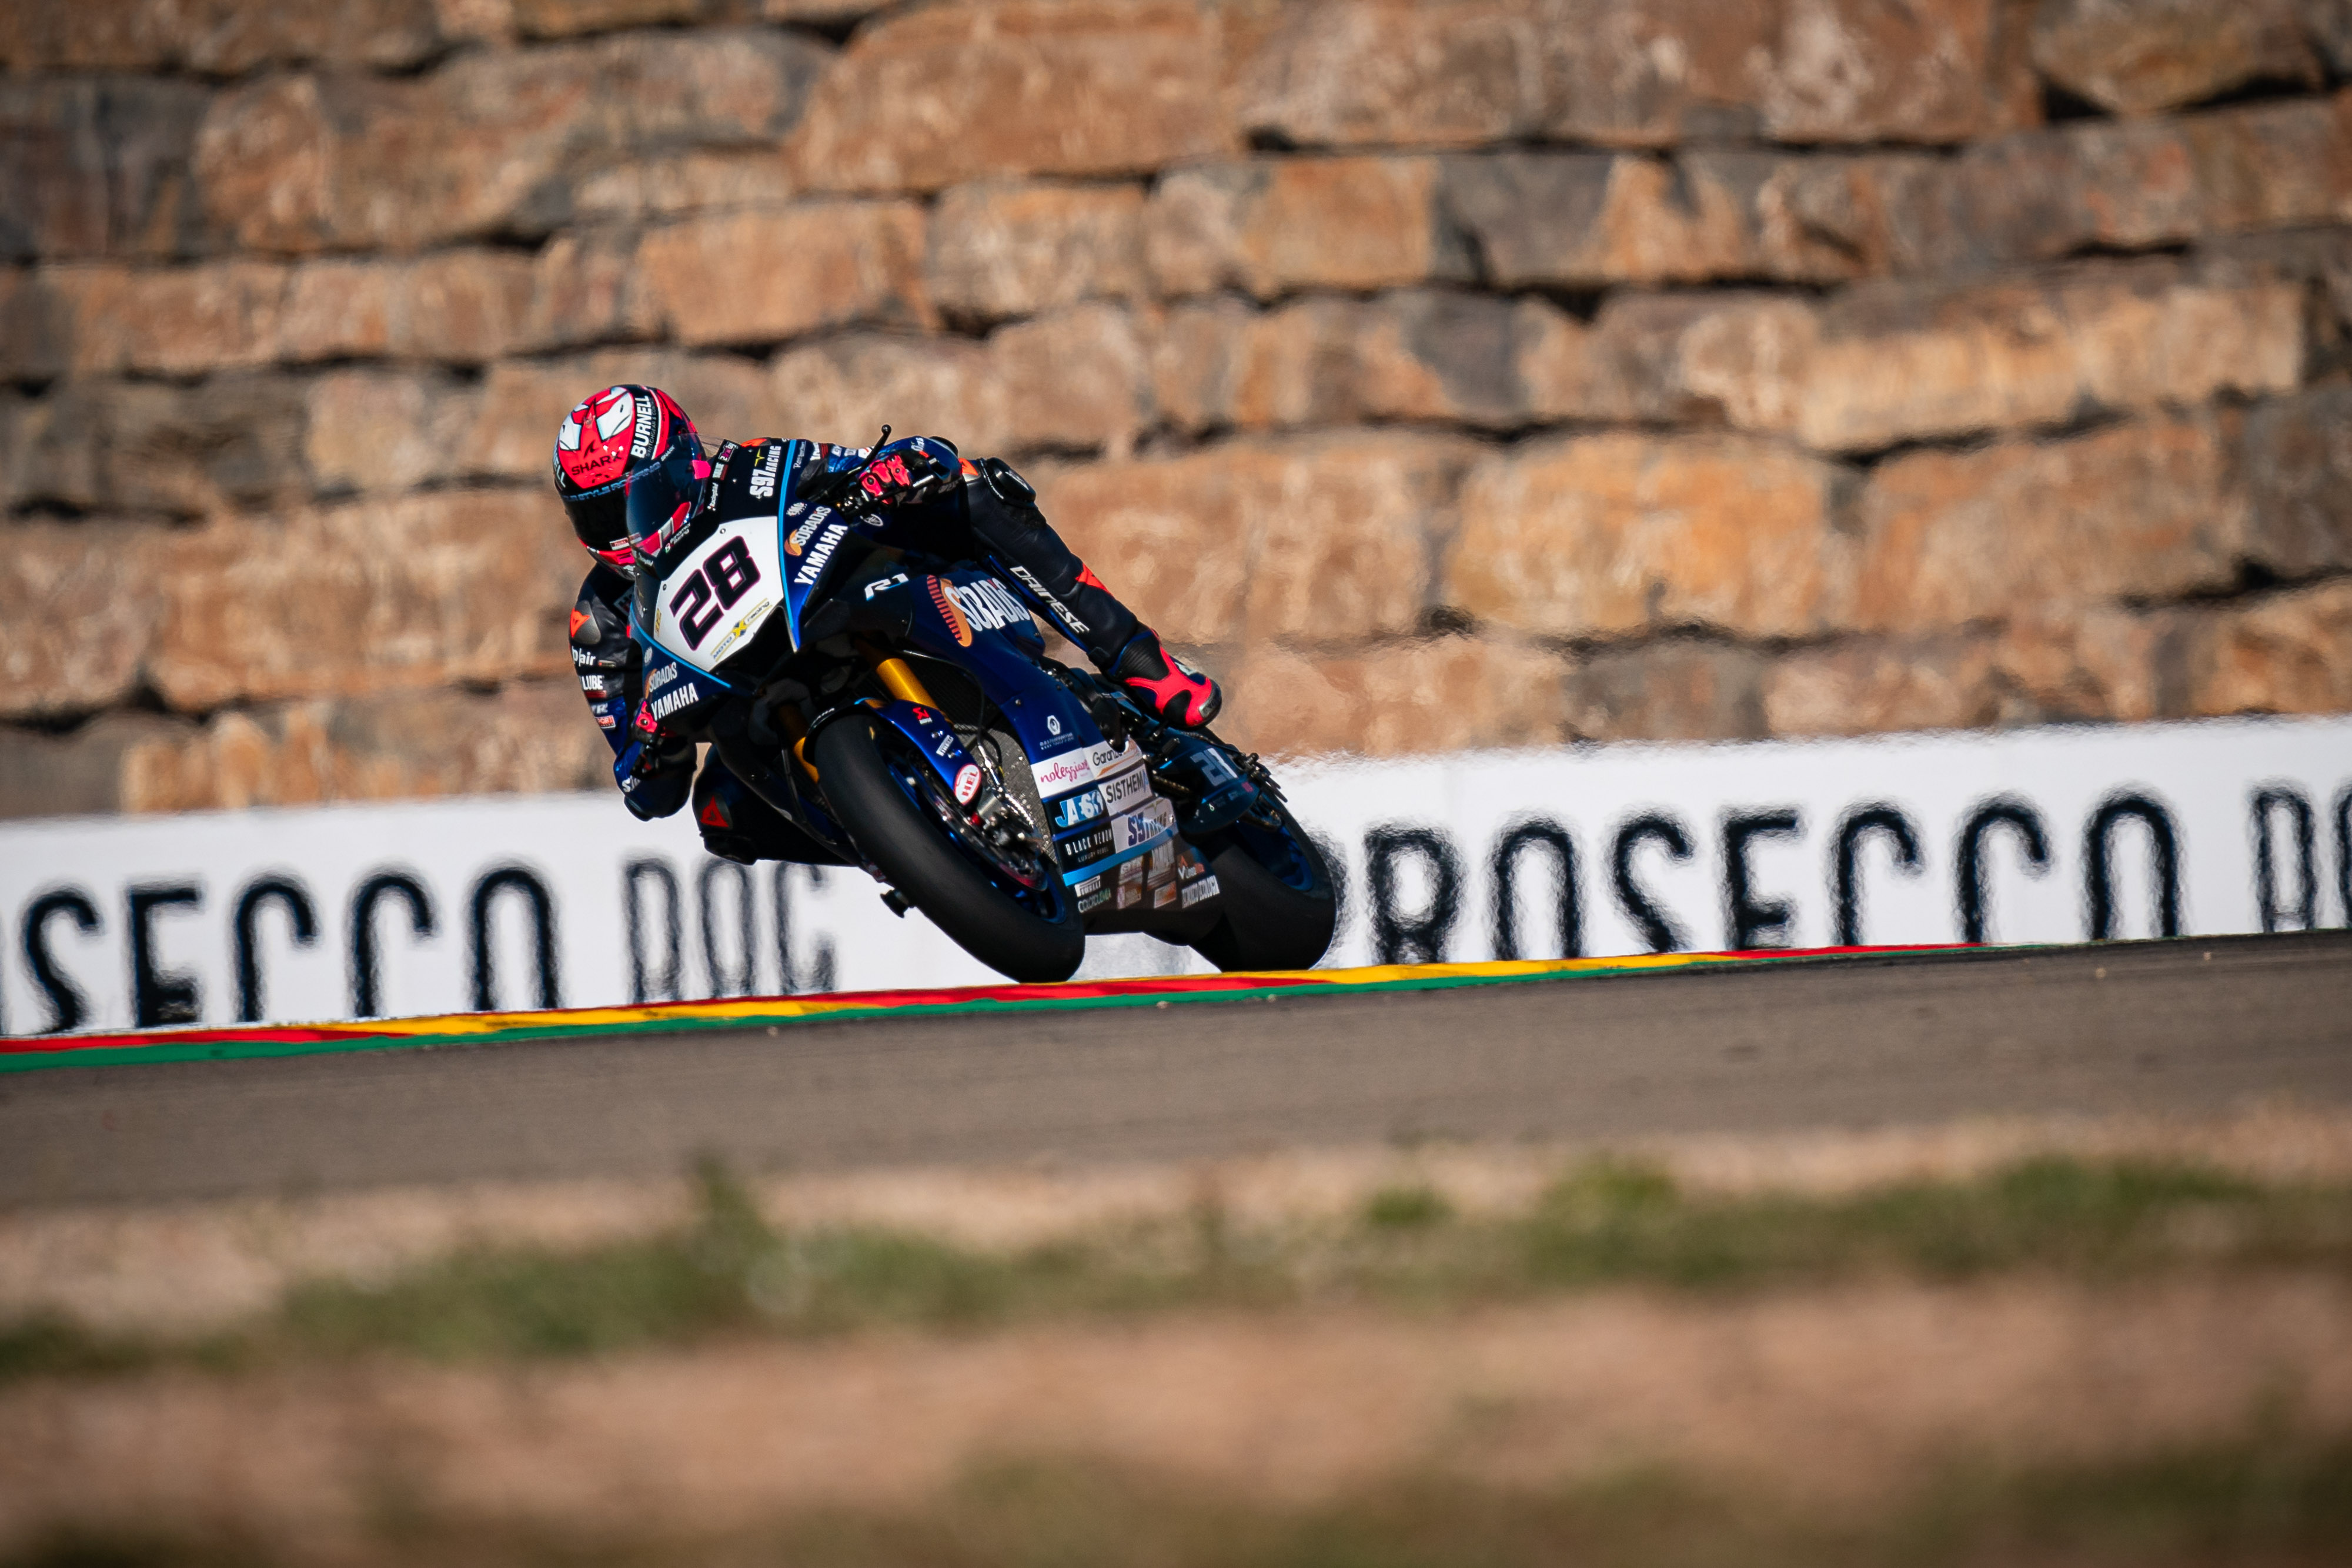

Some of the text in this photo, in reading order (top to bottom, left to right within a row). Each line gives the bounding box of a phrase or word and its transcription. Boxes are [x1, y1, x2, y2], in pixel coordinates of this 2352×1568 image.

[630, 395, 653, 459] BURNELL
[571, 451, 622, 476] SHARK
[749, 445, 782, 499] S97 RACING
[794, 523, 848, 586] YAMAHA
[669, 535, 761, 651] 28
[1009, 566, 1090, 634] DAINESE
[713, 636, 733, 659] MOTO
[580, 675, 604, 690] LUBE
[650, 682, 700, 721] YAMAHA
[1093, 749, 1122, 766] Garan
[961, 771, 978, 797] HEL
[1065, 836, 1092, 856] BLACK
[0, 870, 567, 1036] SECCO
